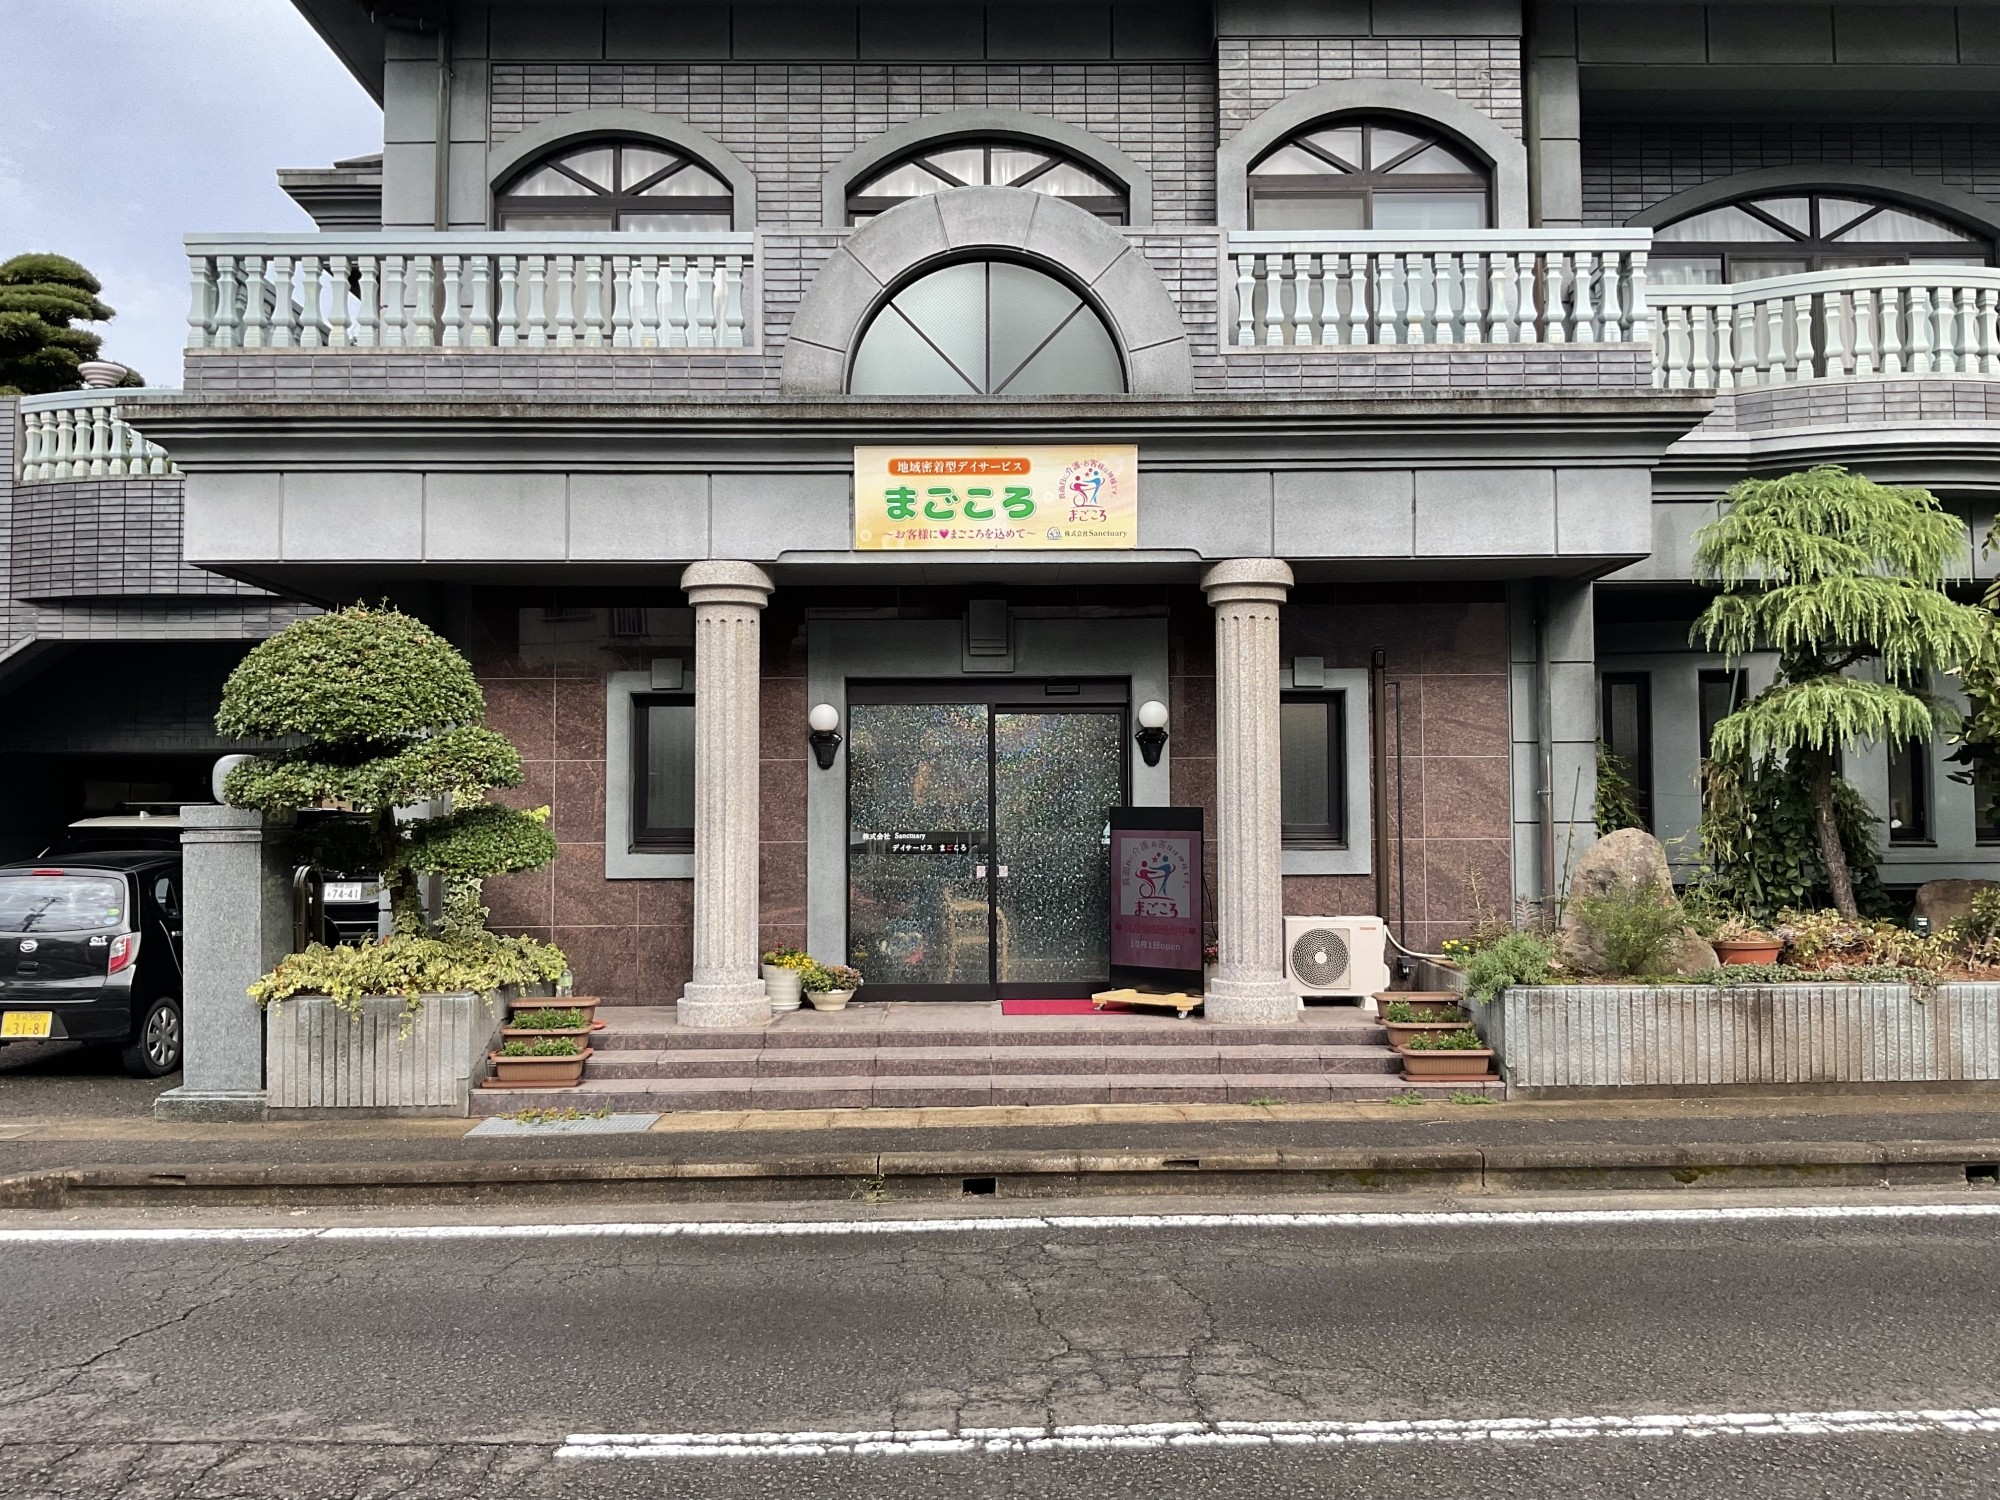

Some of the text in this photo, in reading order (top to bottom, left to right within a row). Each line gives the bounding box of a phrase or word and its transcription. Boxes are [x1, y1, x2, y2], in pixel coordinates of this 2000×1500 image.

[897, 460, 1023, 474] 地域密着型デイサービス
[884, 486, 1036, 520] まごころ
[1068, 509, 1107, 523] まごころ
[862, 832, 926, 840] 株式会社 Sanctuary
[332, 889, 358, 899] 74-41
[1134, 900, 1179, 919] まごころ
[1130, 940, 1181, 951] 10月1日open
[13, 1022, 47, 1035] 31-81
